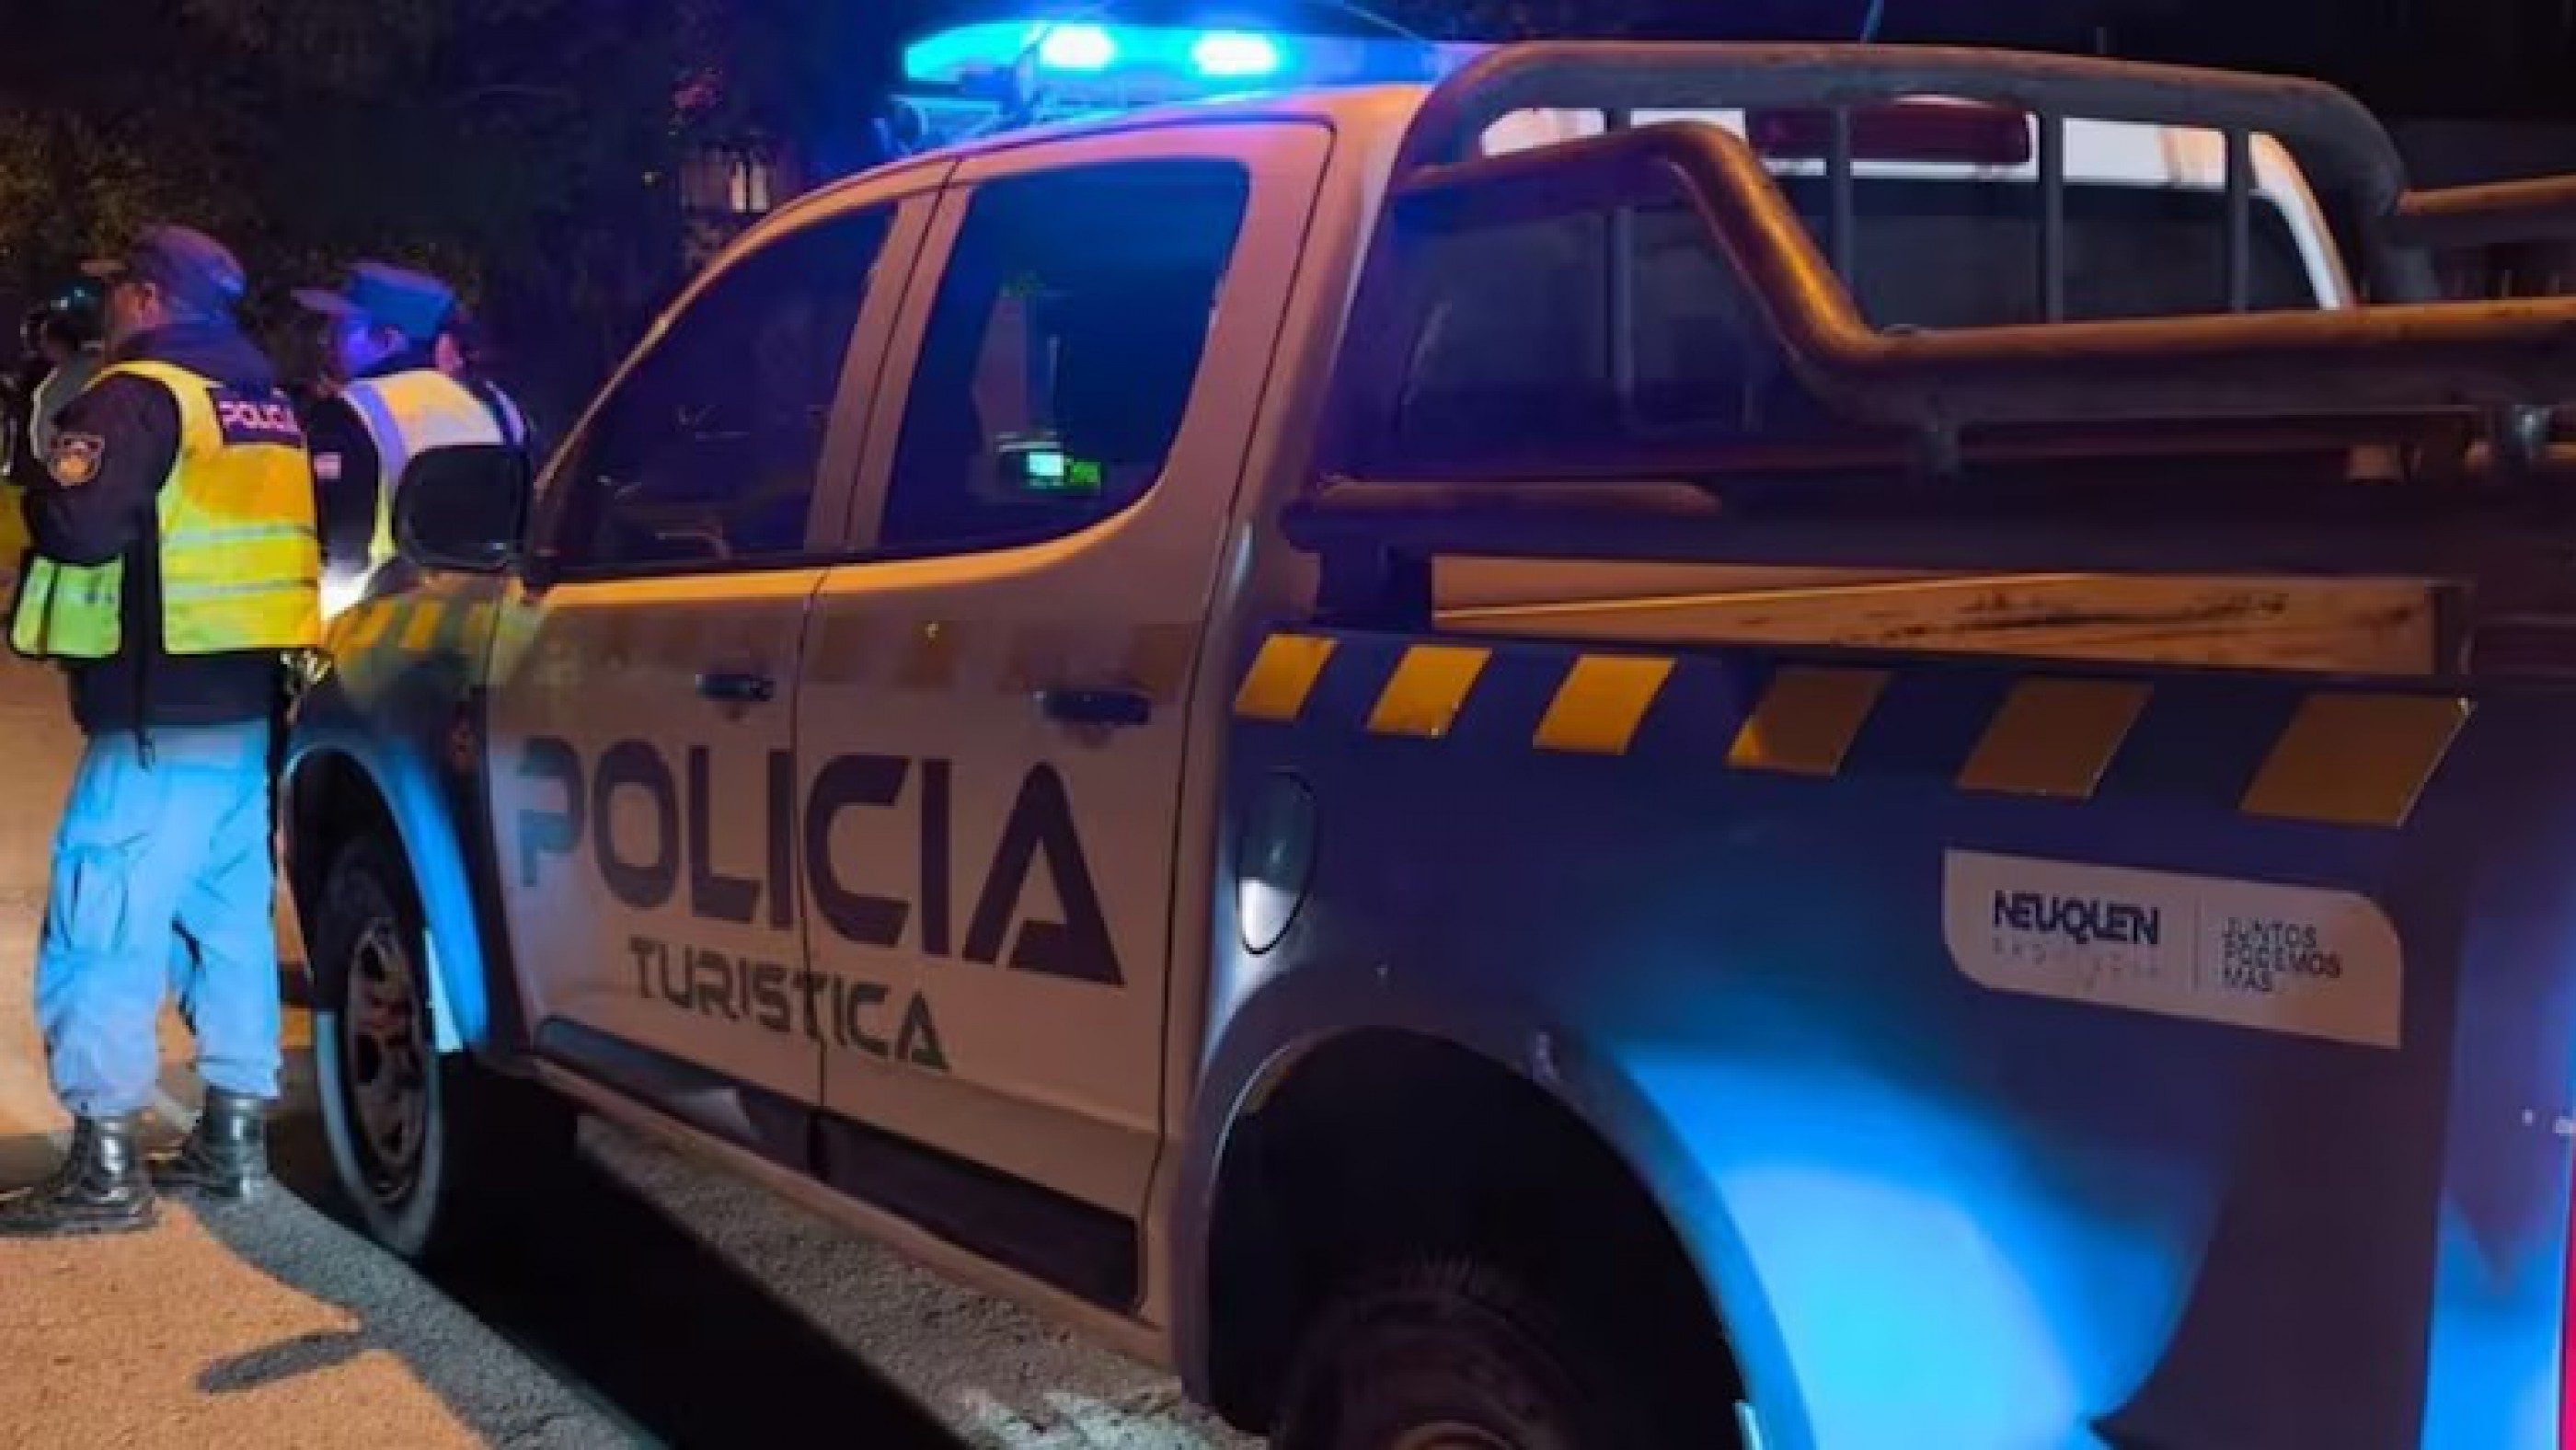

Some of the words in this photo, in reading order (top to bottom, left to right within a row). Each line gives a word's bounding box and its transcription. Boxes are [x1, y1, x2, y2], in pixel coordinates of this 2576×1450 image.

[516, 737, 1125, 986] POLICIA
[1994, 889, 2159, 945] NEUQUEN
[2222, 917, 2317, 949] JUNTOS
[629, 935, 949, 1072] TURISTICA
